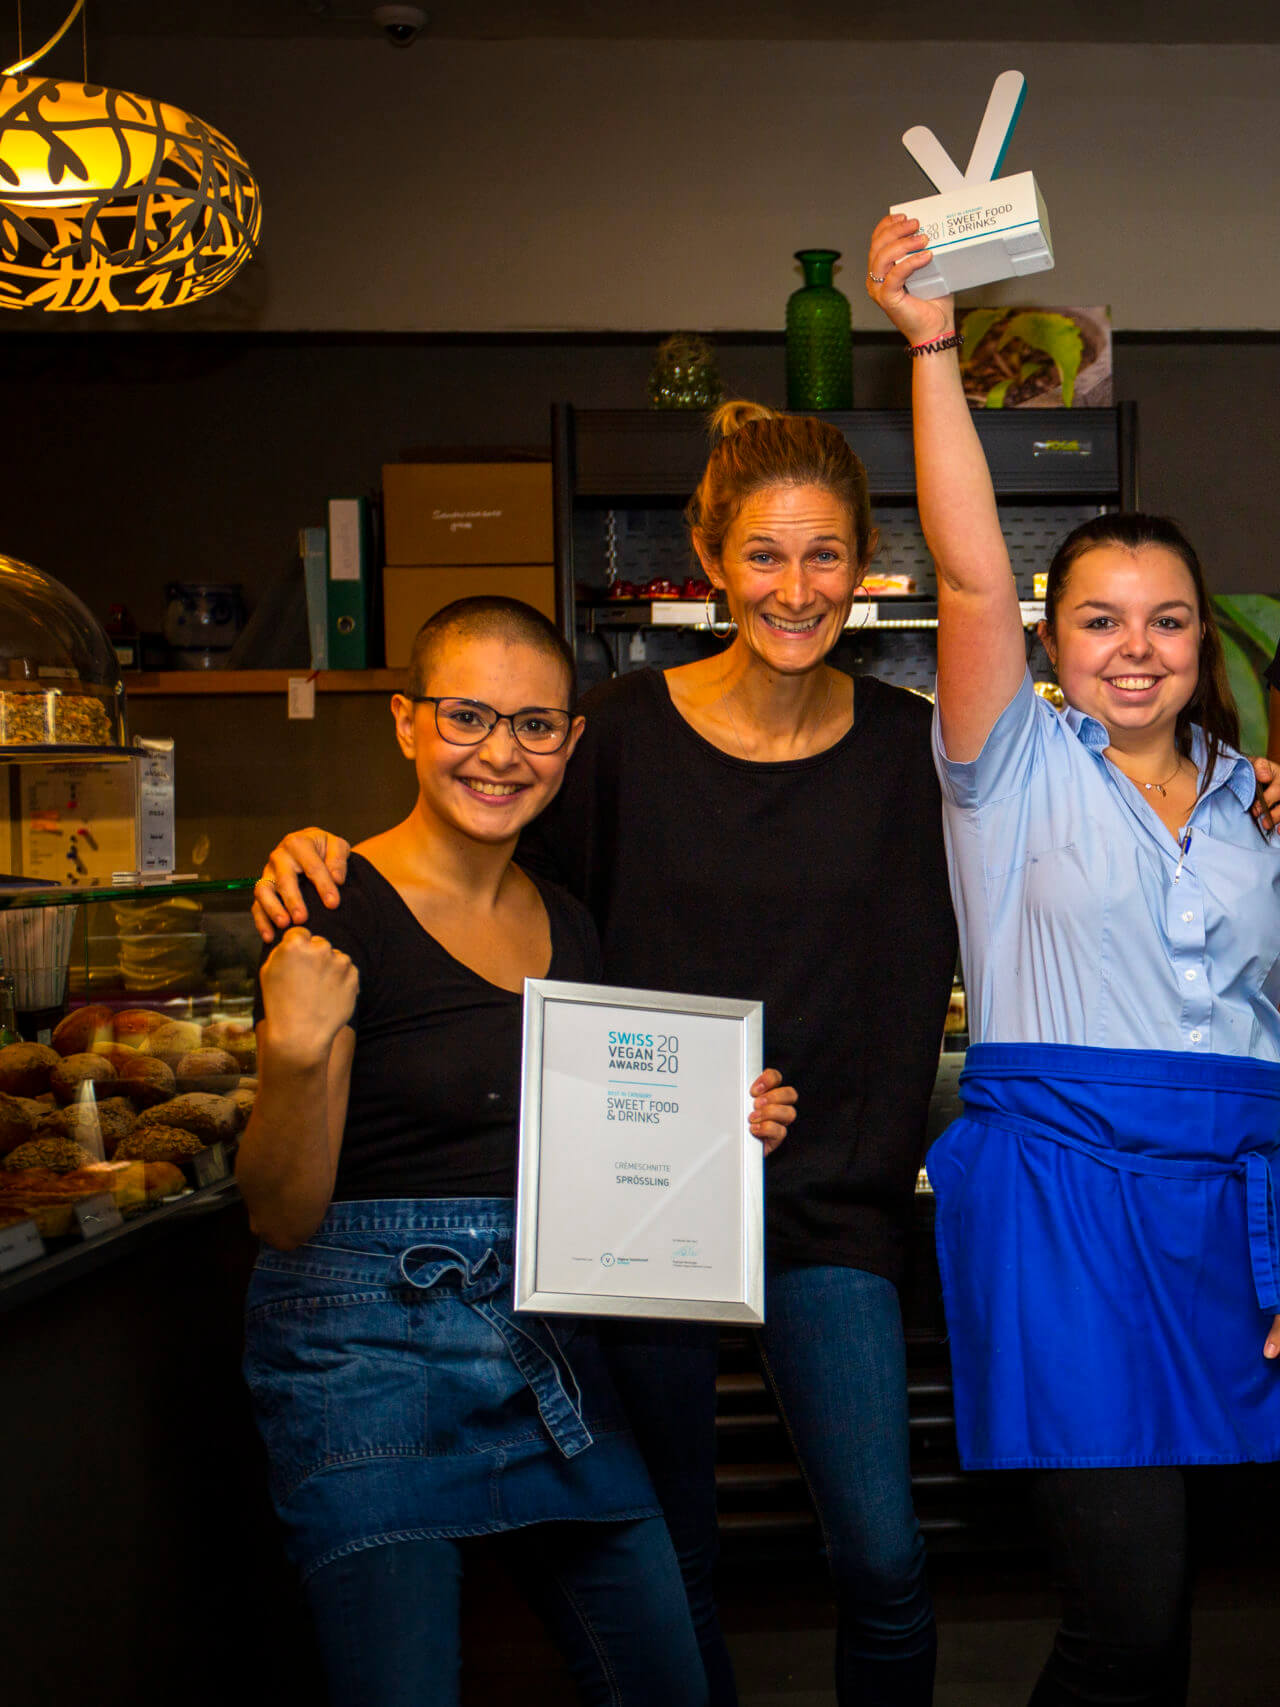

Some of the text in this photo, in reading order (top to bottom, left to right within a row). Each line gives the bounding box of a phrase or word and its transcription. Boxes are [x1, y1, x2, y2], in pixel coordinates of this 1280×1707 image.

[946, 210, 982, 227] SWEET
[985, 203, 1013, 218] FOOD
[948, 216, 997, 236] & DRINKS
[608, 1031, 654, 1047] SWISS
[656, 1034, 679, 1054] 20
[608, 1045, 653, 1061] VEGAN
[608, 1059, 654, 1072] AWARDS
[656, 1054, 679, 1074] 20
[607, 1097, 679, 1113] SWEET FOOD
[607, 1110, 660, 1124] & DRINKS
[616, 1175, 670, 1187] SPRÖSSLING
